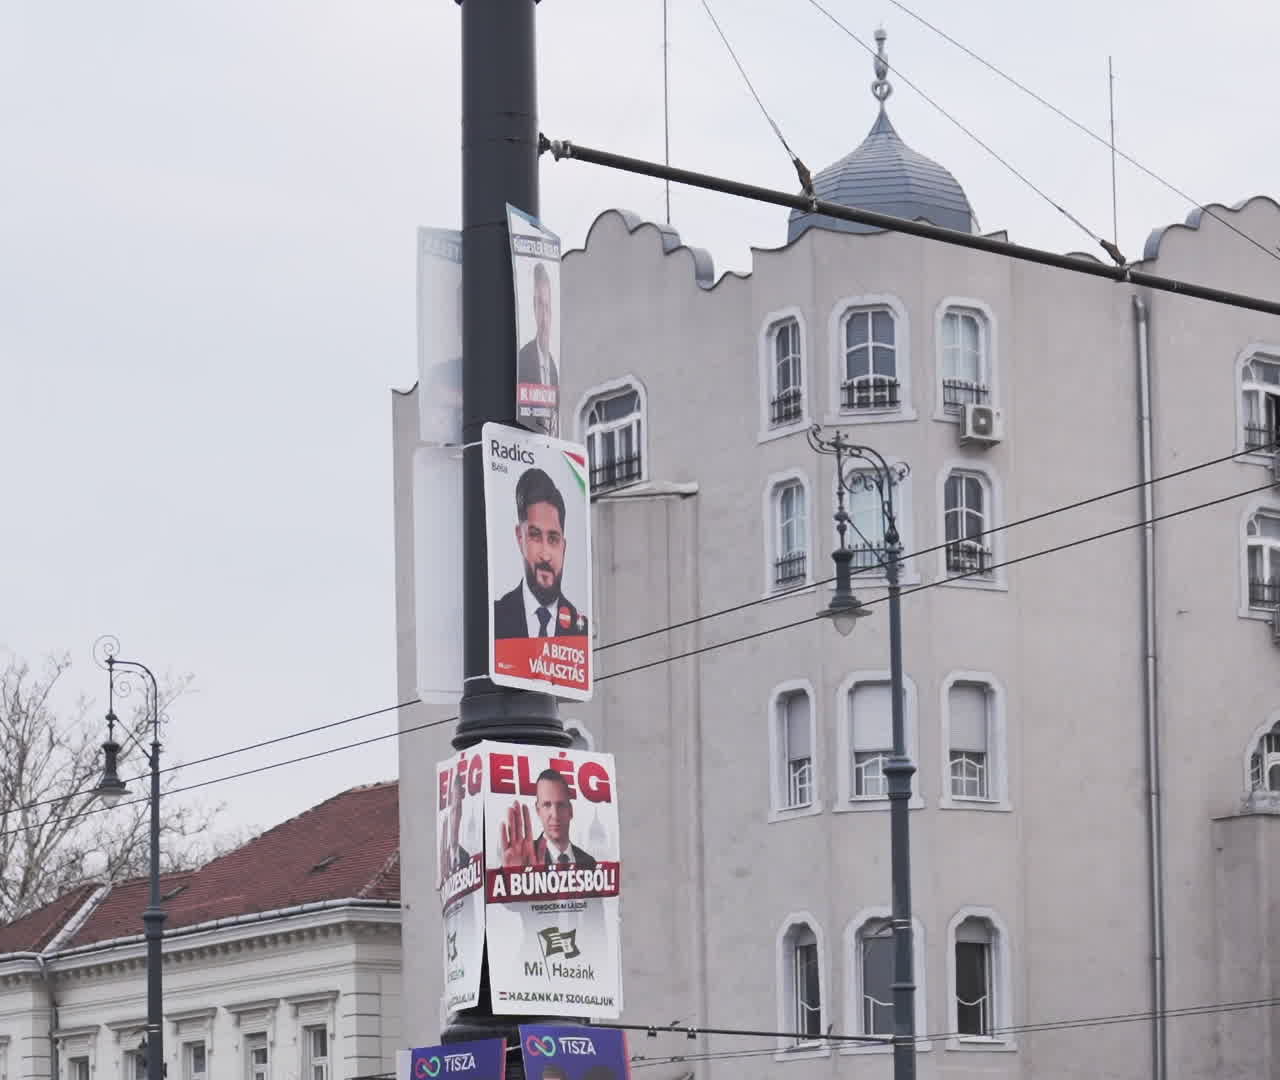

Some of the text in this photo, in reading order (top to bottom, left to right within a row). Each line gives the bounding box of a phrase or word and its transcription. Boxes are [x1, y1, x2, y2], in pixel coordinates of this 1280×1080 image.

[491, 440, 535, 465] Radics
[542, 642, 585, 664] A BIZTOS
[529, 656, 585, 683] VÁLASZTÁS
[489, 752, 612, 804] ELÉG
[492, 864, 616, 897] A BŰNÖZÉSBŐL!
[524, 961, 595, 981] Mi Hazánk
[559, 1037, 596, 1056] TISZA
[444, 1053, 476, 1072] TISZA
